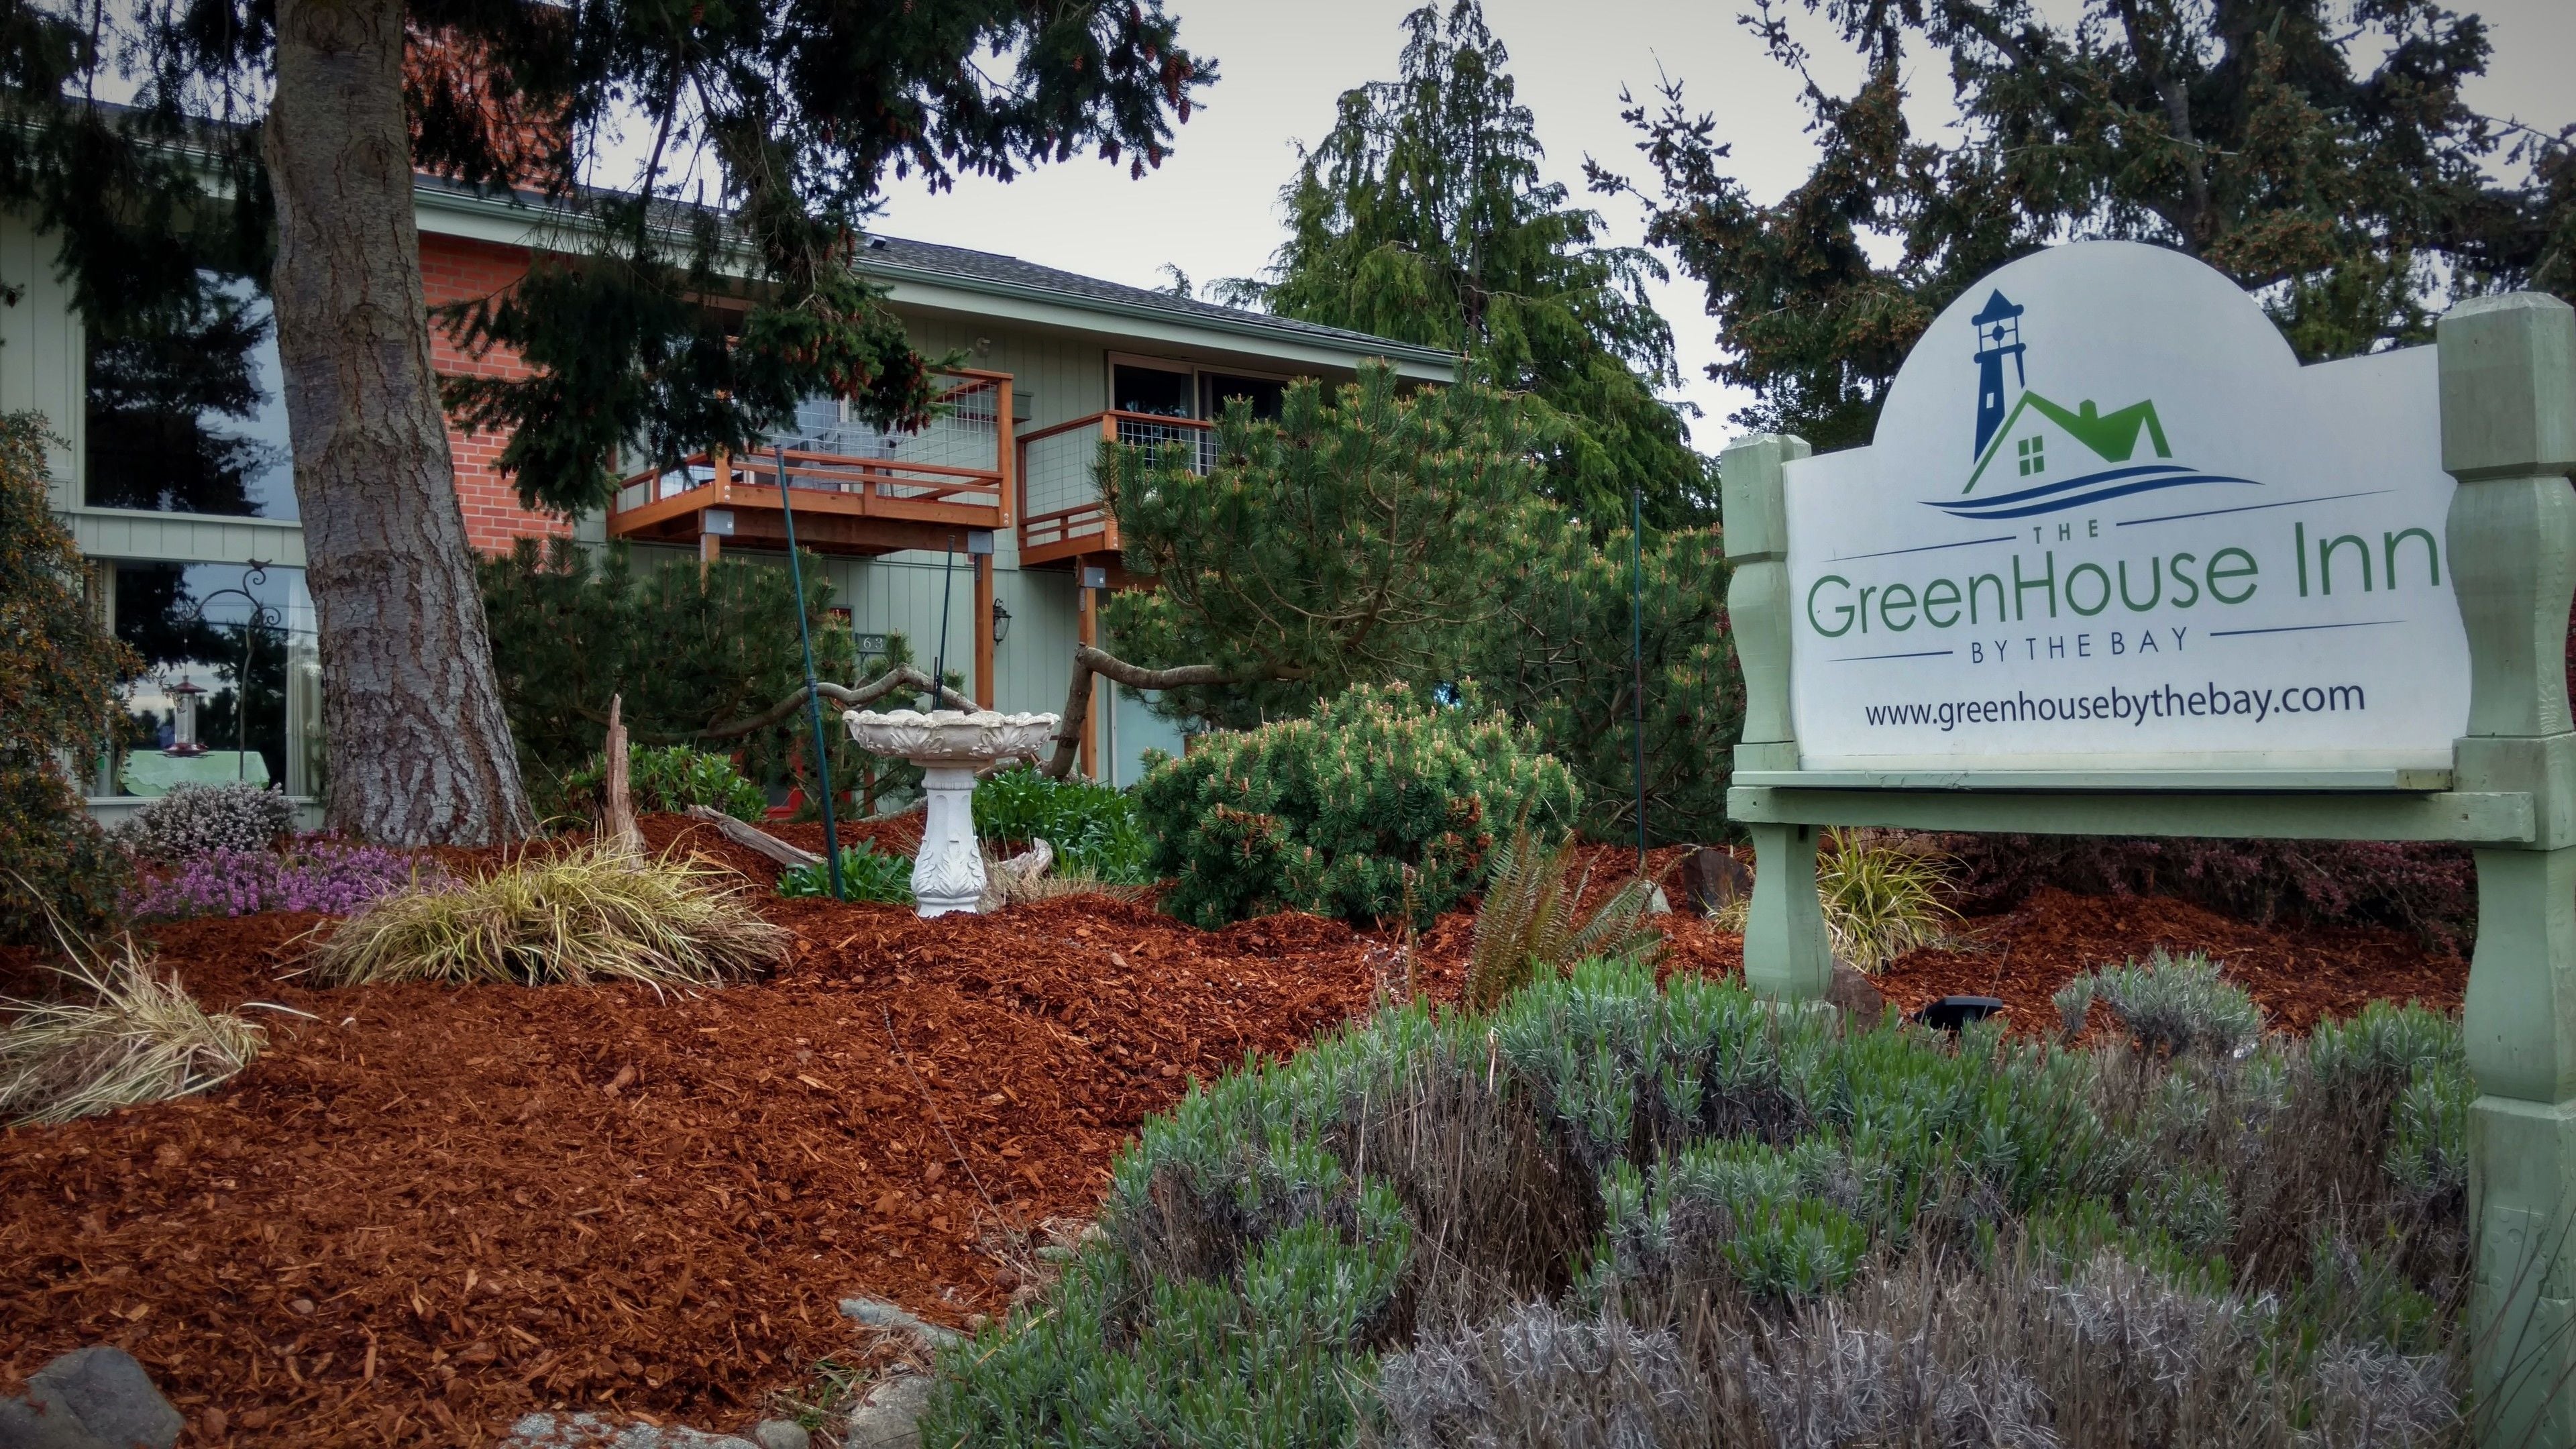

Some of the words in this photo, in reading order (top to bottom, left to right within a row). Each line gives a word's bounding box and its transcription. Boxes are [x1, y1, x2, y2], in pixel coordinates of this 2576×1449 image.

[2033, 519, 2098, 544] THE
[1807, 547, 2259, 638] GreenHouse
[2295, 521, 2440, 597] Inn
[1972, 639, 2008, 663] BY
[2026, 634, 2092, 660] THE
[2111, 627, 2187, 655] BAY
[1866, 682, 2365, 732] www.greenhousebythebay.com
